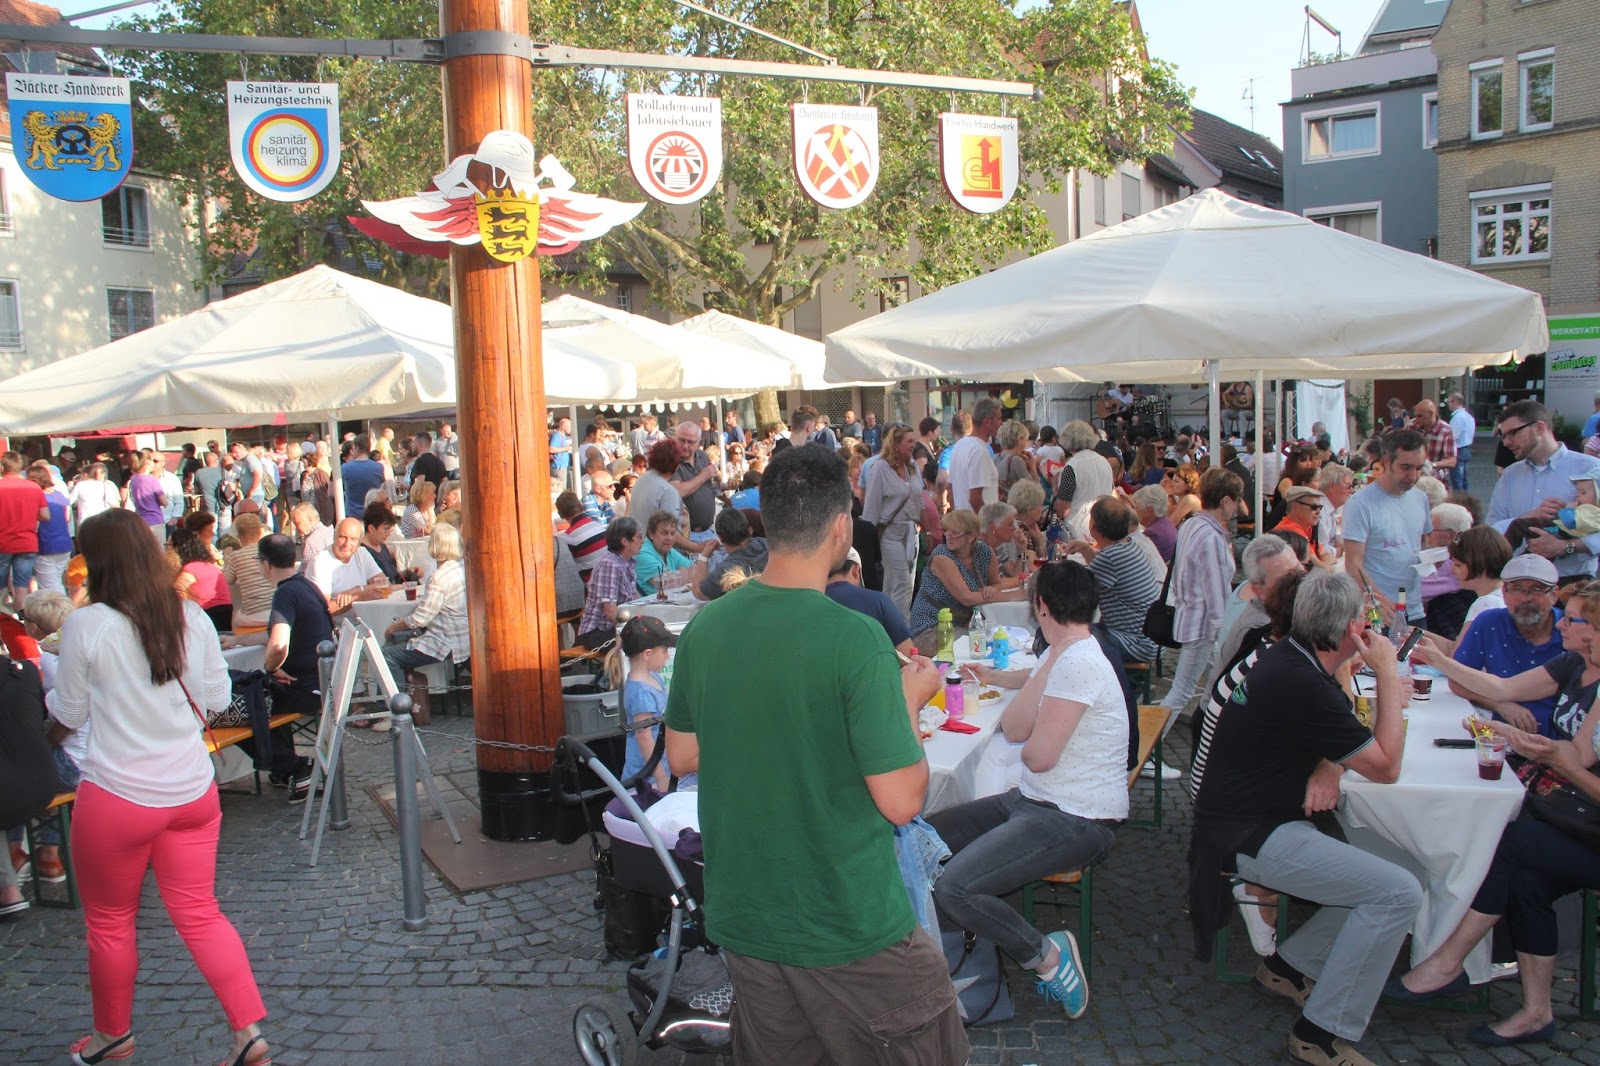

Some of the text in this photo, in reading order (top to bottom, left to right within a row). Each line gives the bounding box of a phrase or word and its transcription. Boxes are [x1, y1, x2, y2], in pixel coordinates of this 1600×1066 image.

[246, 83, 320, 94] Sanitär- und
[234, 94, 332, 107] Heizungstechnik
[637, 113, 713, 128] Jalousiebauer
[269, 134, 308, 145] sanitär
[261, 145, 307, 157] heizung
[276, 156, 308, 167] klima
[1551, 326, 1600, 336] WERKSTATT
